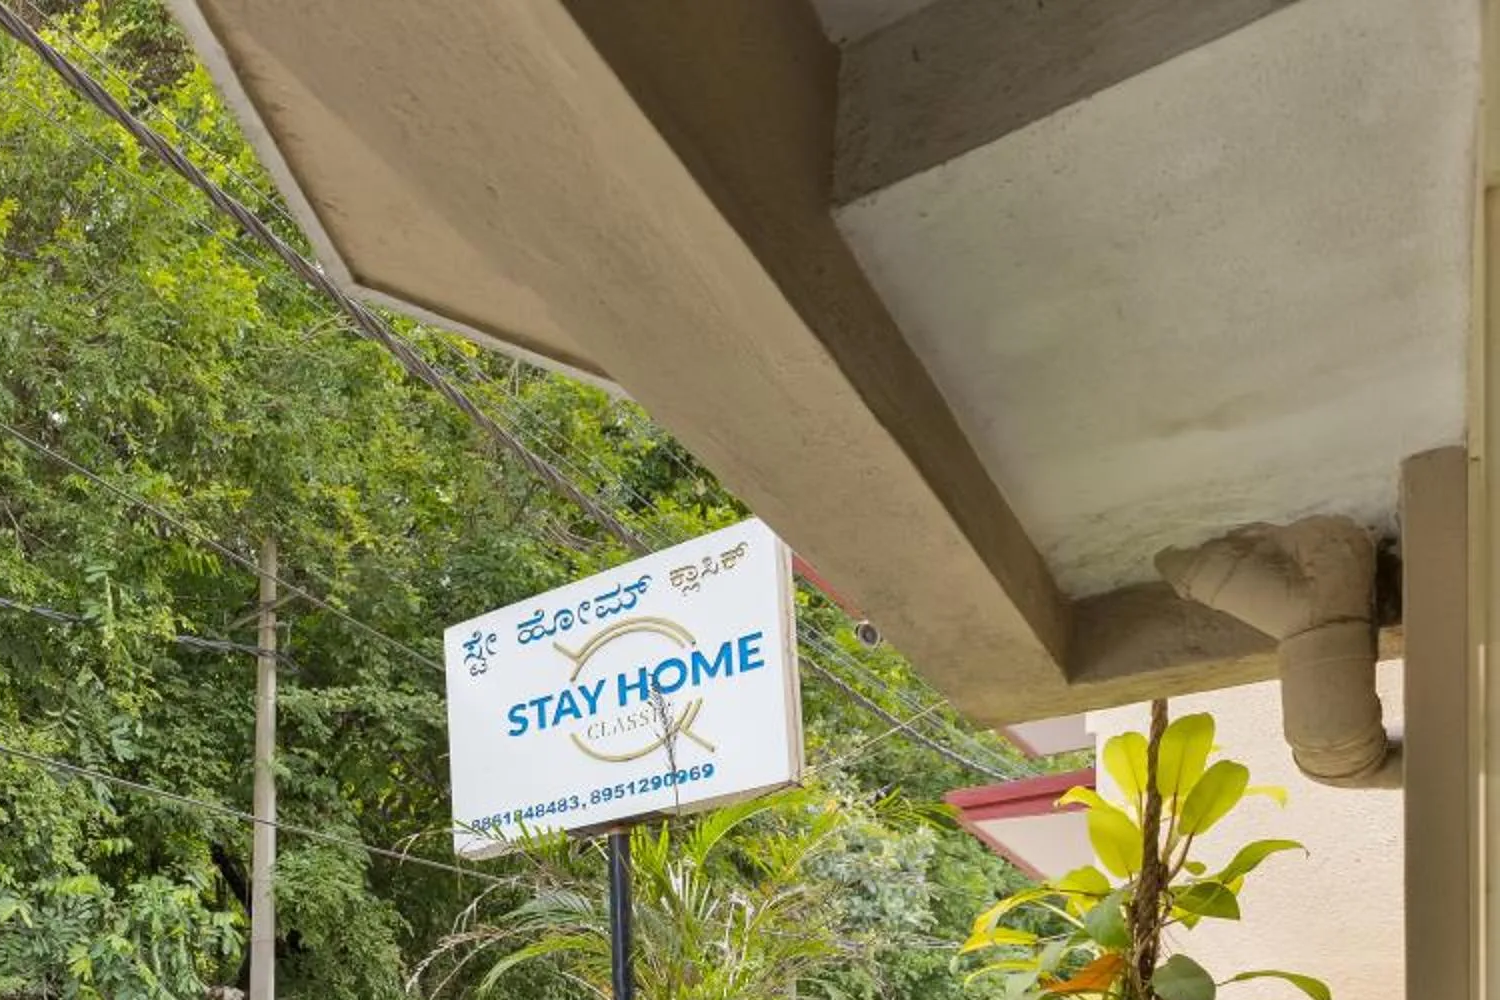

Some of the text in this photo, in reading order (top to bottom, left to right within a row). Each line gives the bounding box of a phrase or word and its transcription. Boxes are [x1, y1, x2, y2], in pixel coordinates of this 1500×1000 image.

[507, 631, 765, 737] STAY HOME
[586, 703, 673, 740] CLASSI
